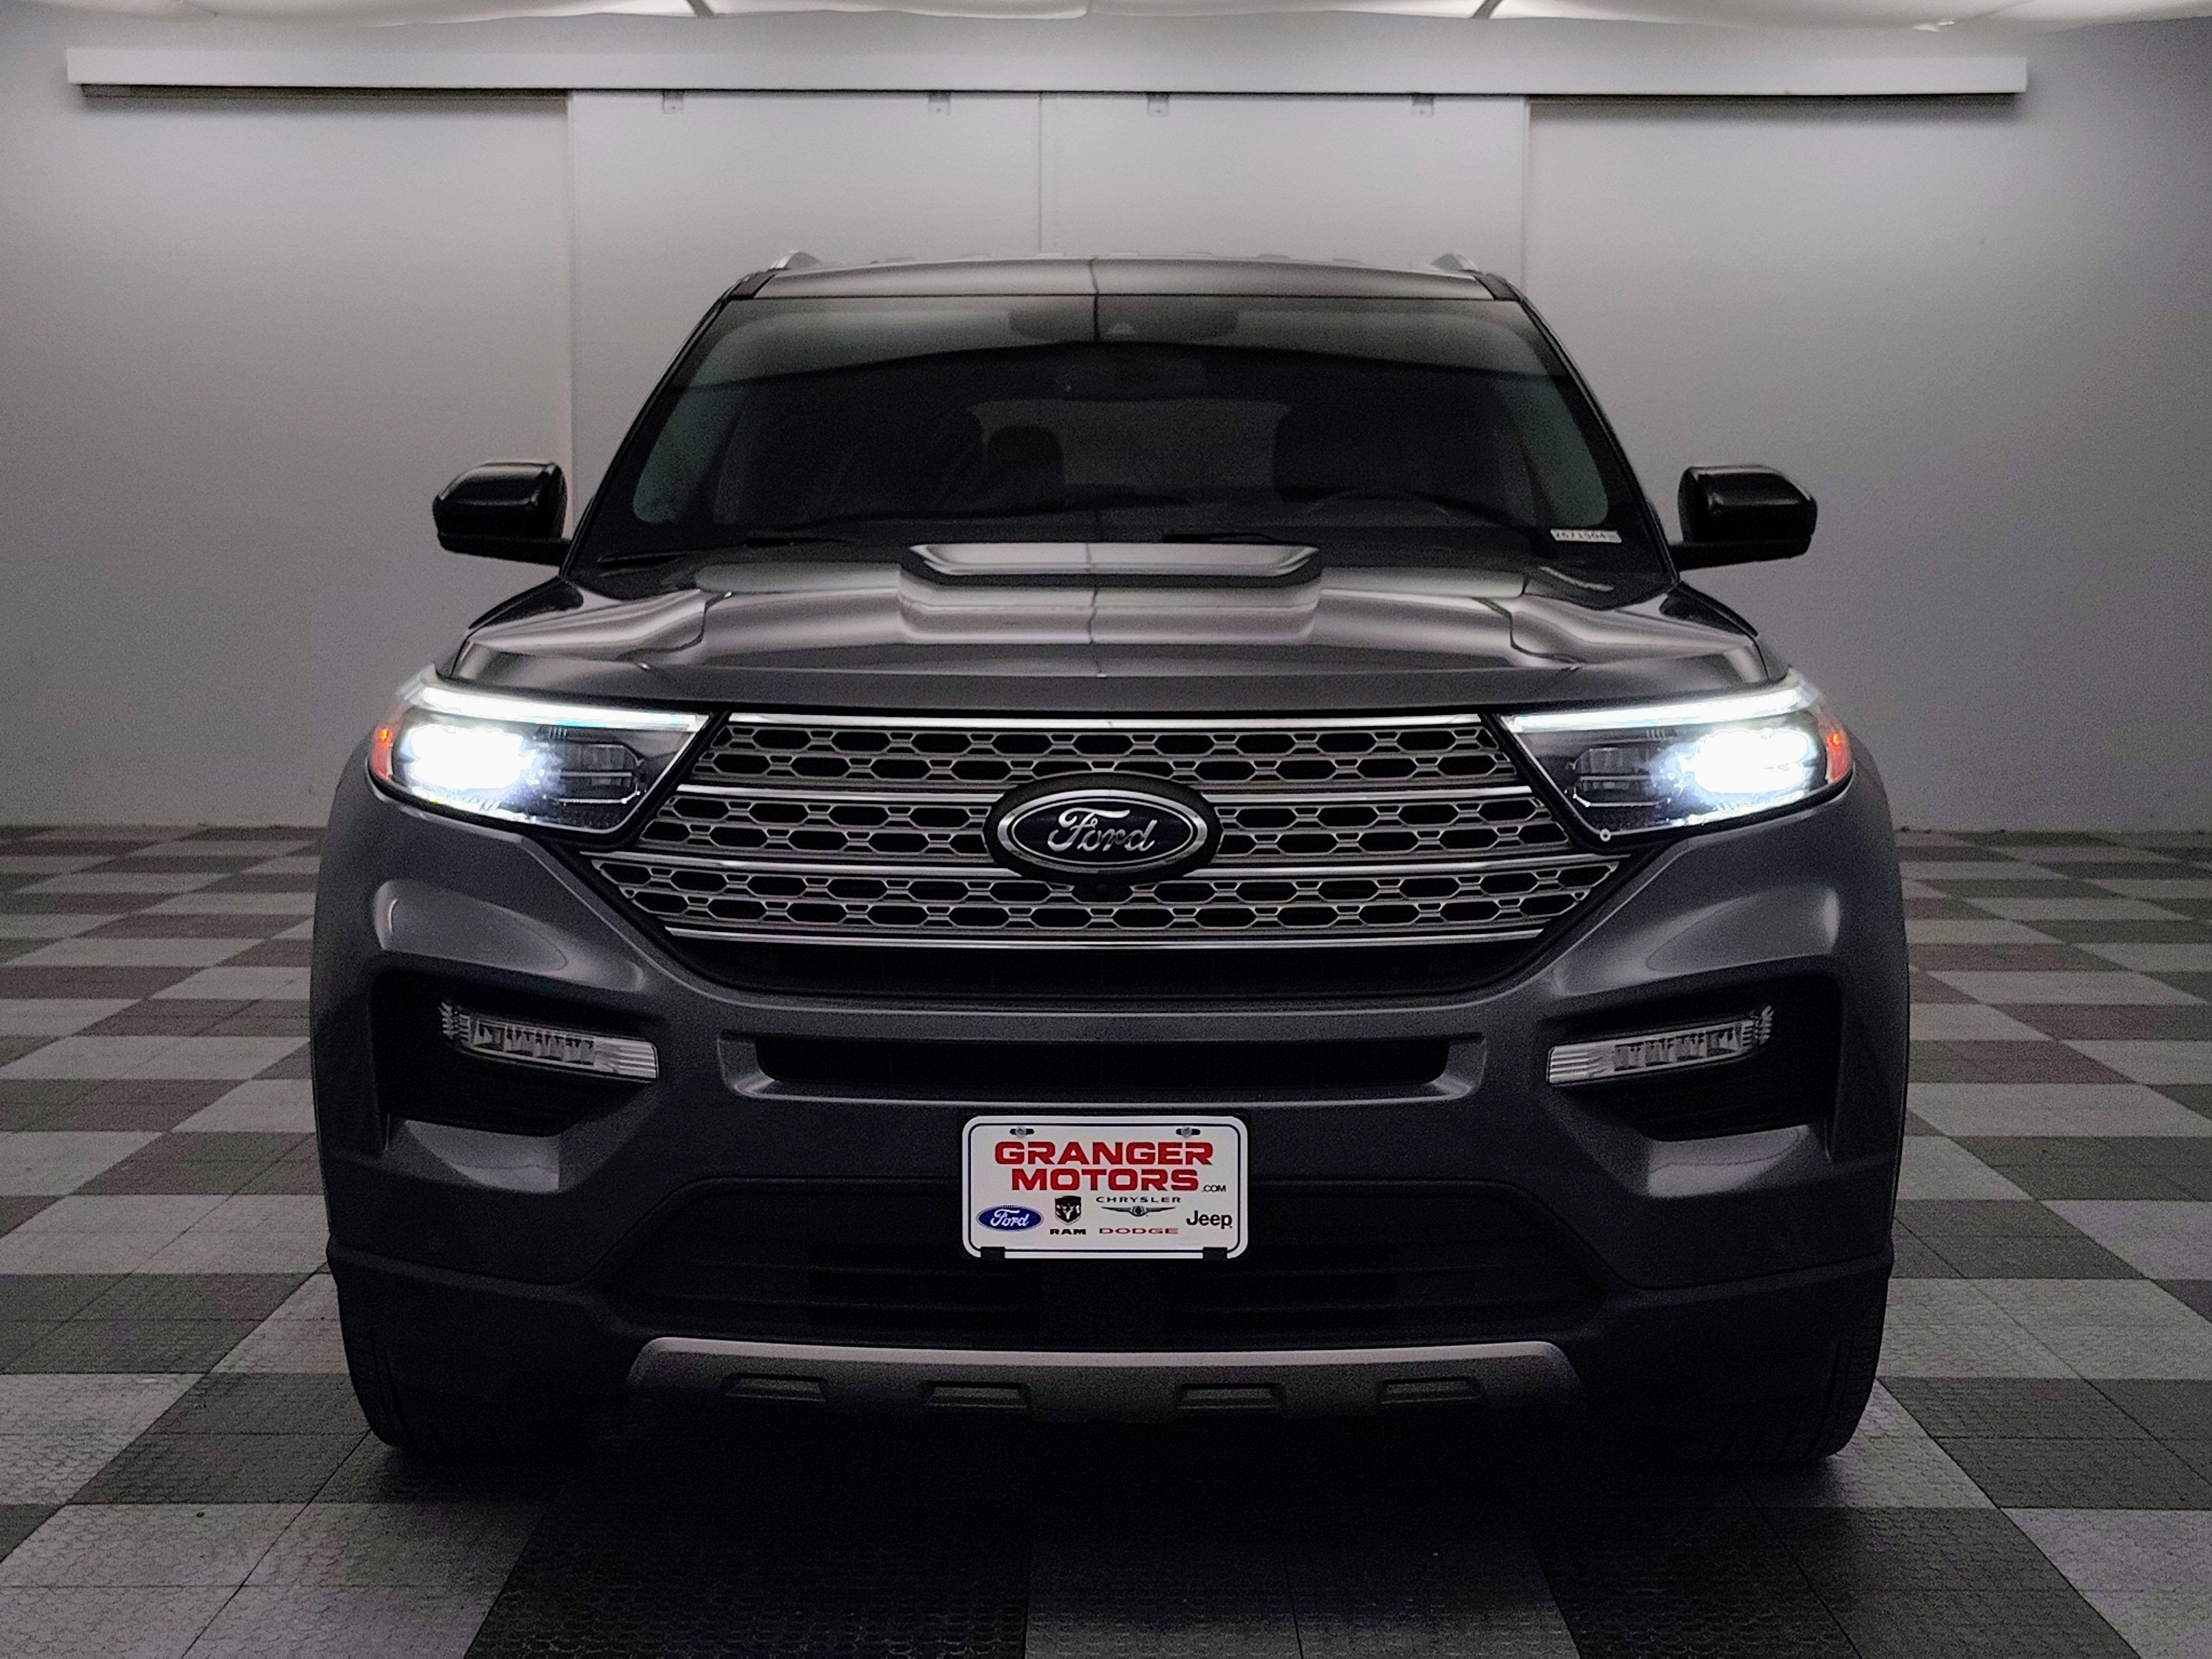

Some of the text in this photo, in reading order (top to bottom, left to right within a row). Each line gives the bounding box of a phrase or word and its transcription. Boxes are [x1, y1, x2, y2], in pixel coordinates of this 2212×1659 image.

[1047, 807, 1158, 852] Ford
[994, 1142, 1213, 1165] GRANGER
[1011, 1168, 1199, 1191] MOTORS
[990, 1209, 1030, 1226] Ford
[1186, 1210, 1232, 1229] Jeep
